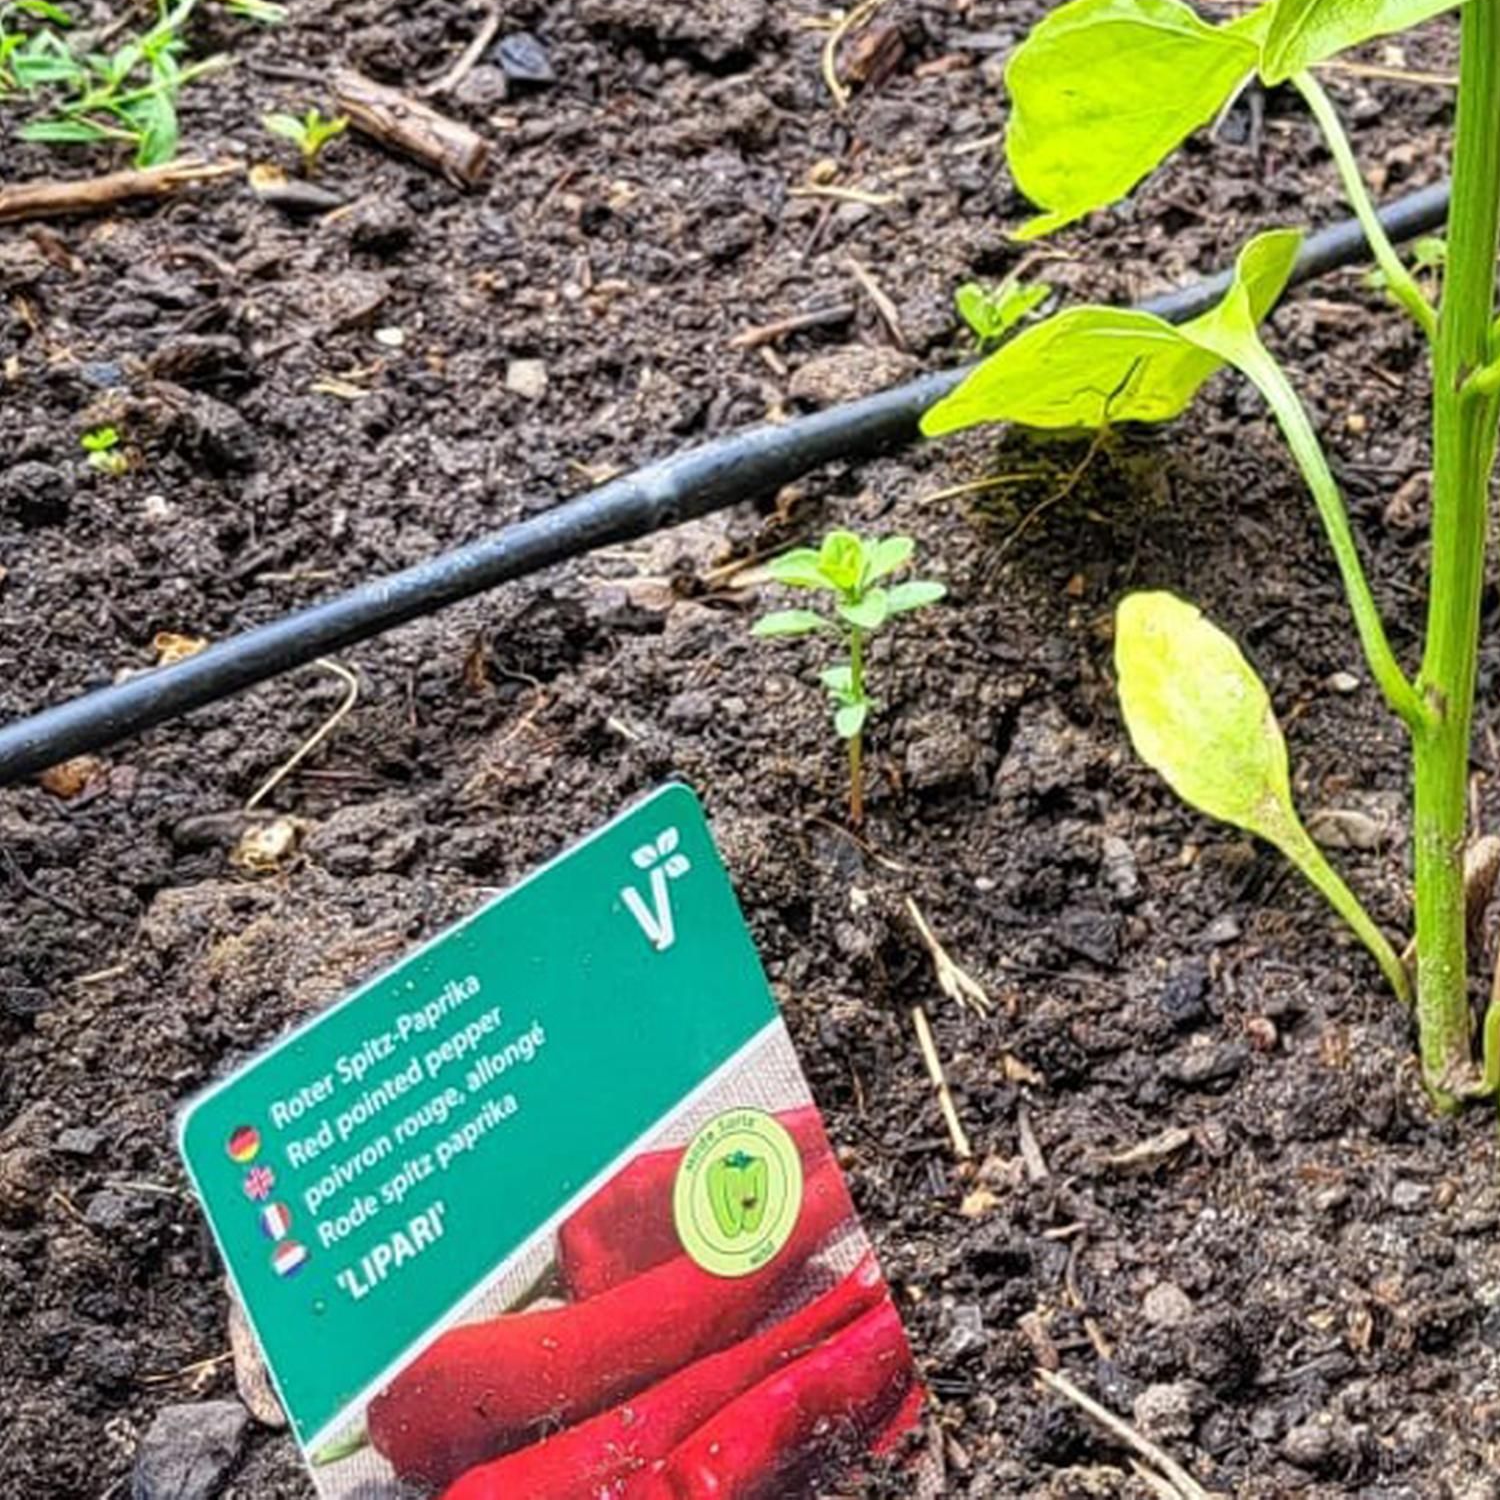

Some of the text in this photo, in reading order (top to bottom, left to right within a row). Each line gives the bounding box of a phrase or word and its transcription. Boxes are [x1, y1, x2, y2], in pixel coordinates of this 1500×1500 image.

[269, 974, 481, 1129] Roter Spitz-Paprika
[286, 1006, 502, 1168] Red pointed pepper
[304, 1020, 546, 1215] poivron rouge, allongé
[317, 1093, 518, 1248] Rode spitz paprika
[337, 1202, 447, 1299] 'LIPARI'
